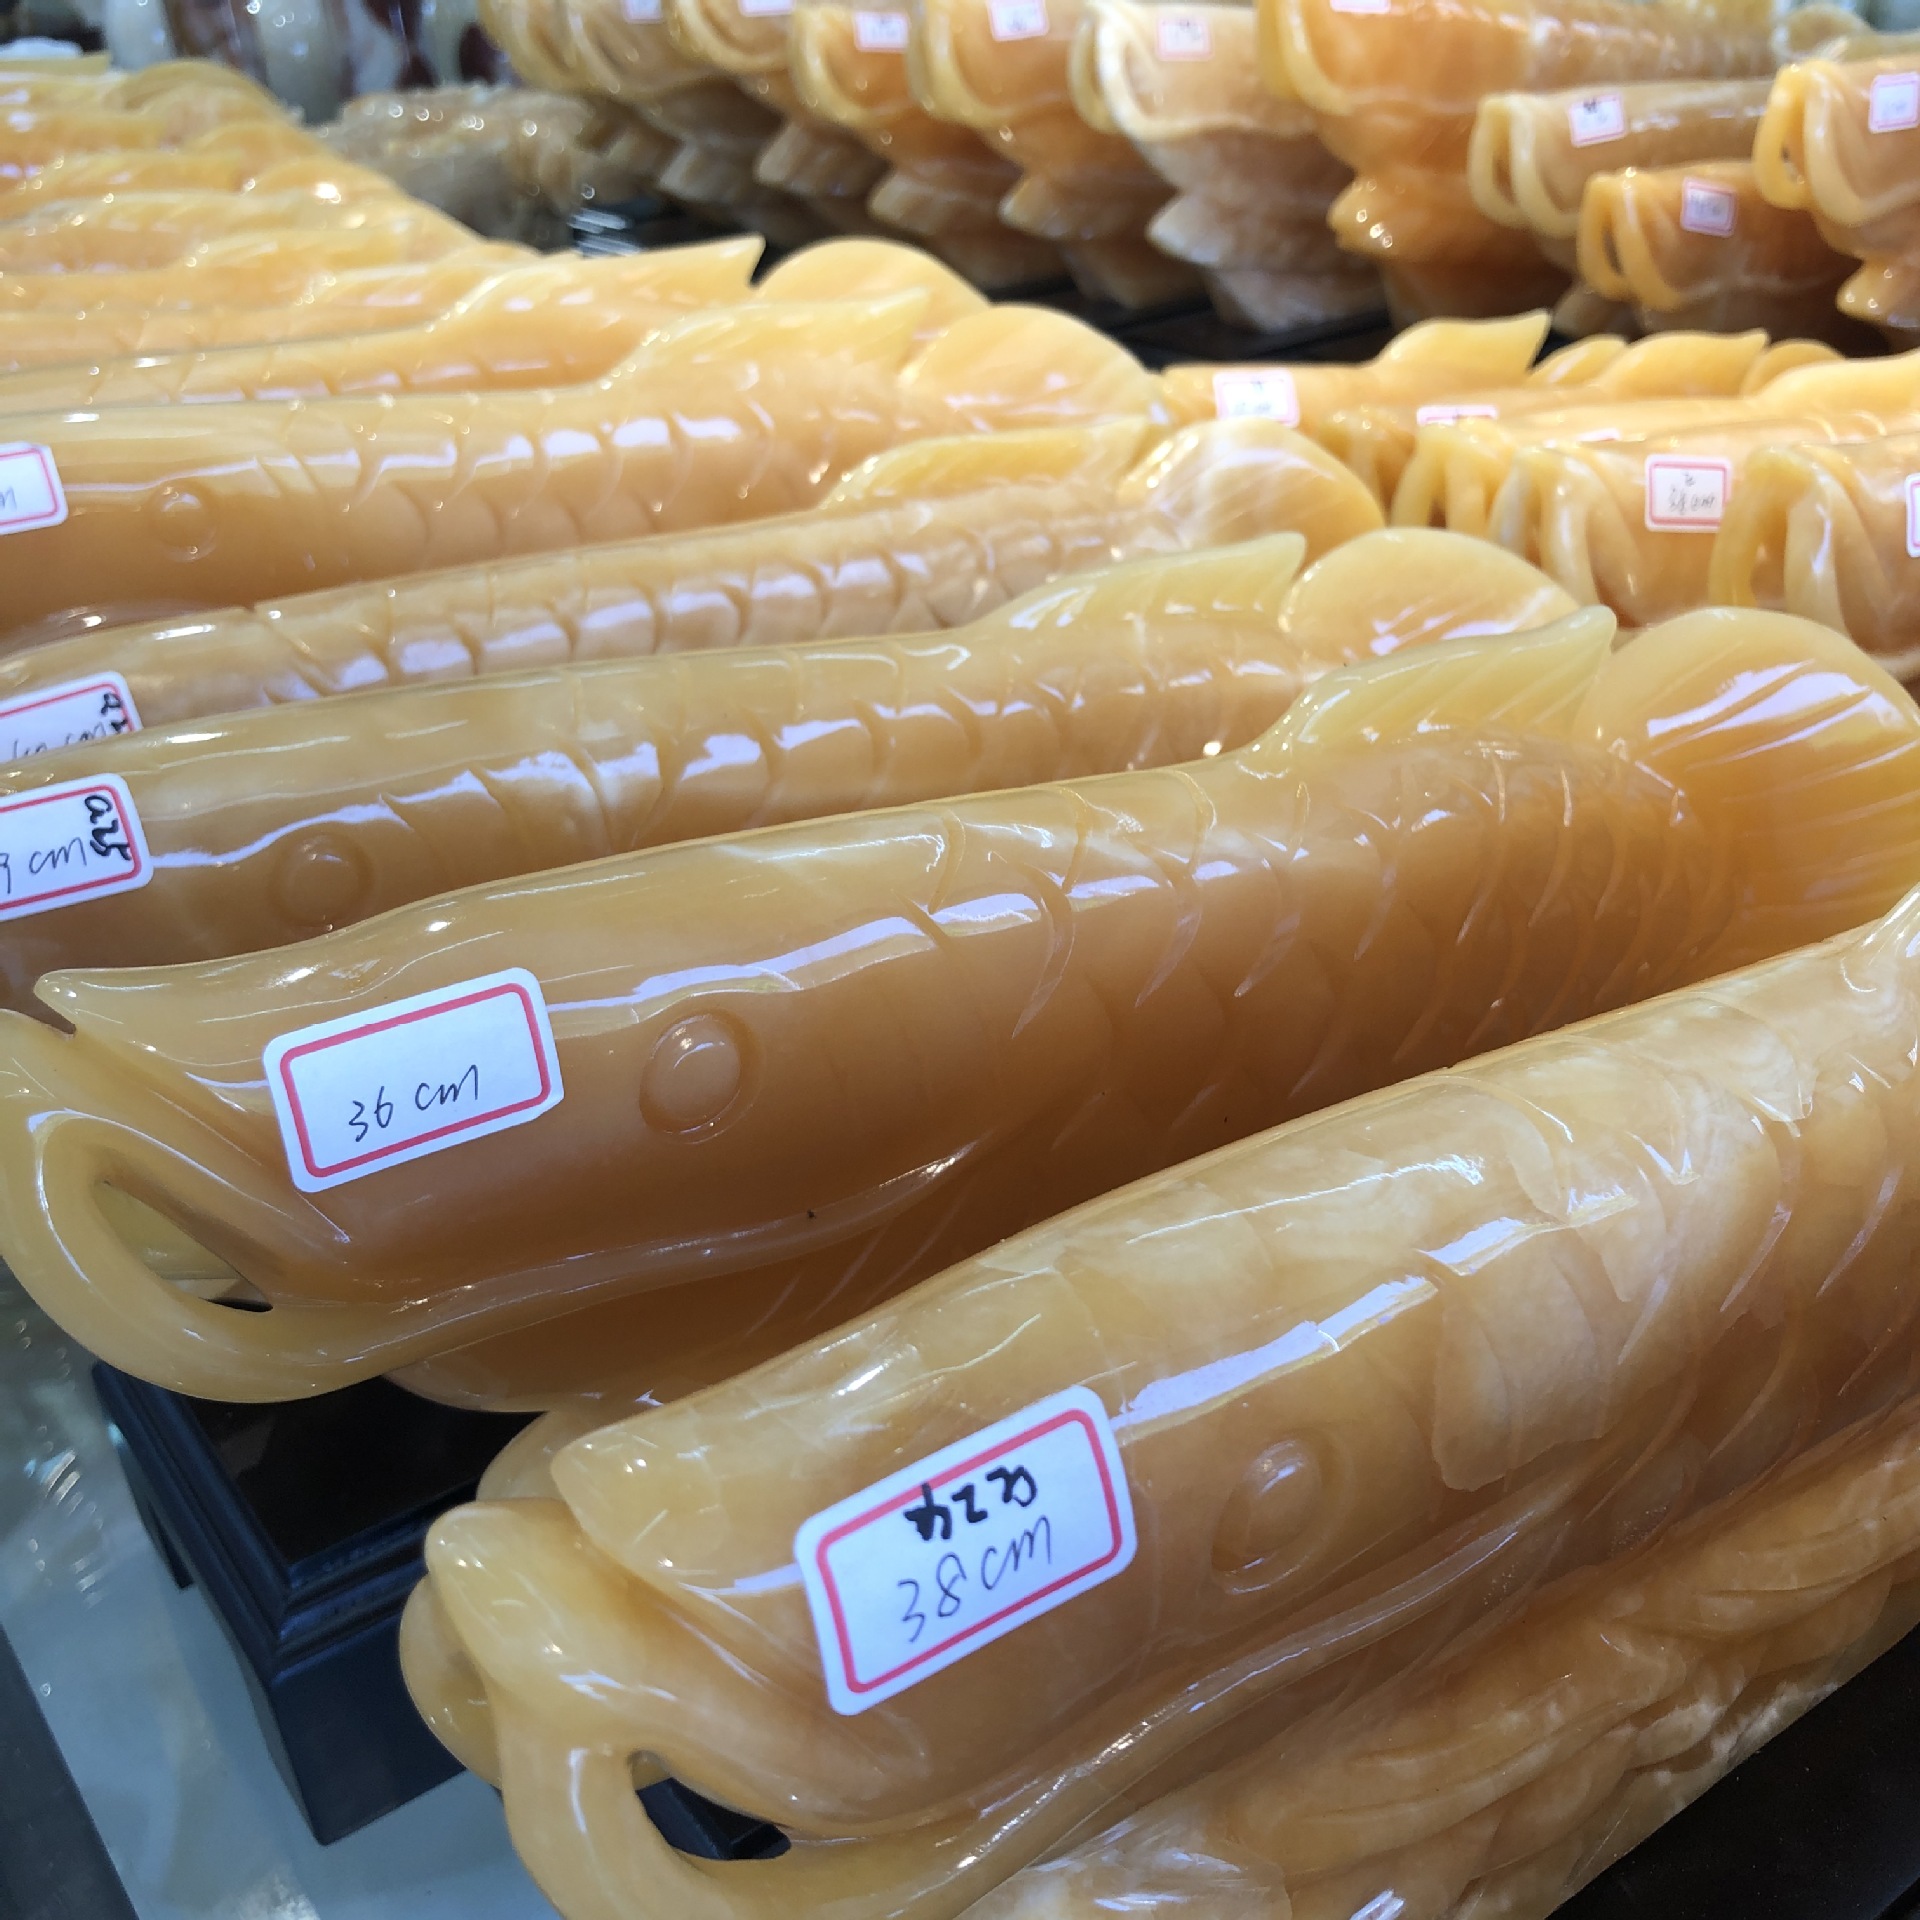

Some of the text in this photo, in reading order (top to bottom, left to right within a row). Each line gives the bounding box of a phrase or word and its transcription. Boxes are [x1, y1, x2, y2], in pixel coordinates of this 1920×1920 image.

[28, 836, 88, 876] cm
[84, 794, 132, 862] a25
[348, 1064, 480, 1143] 36 cm
[896, 1514, 1052, 1643] 38 cm
